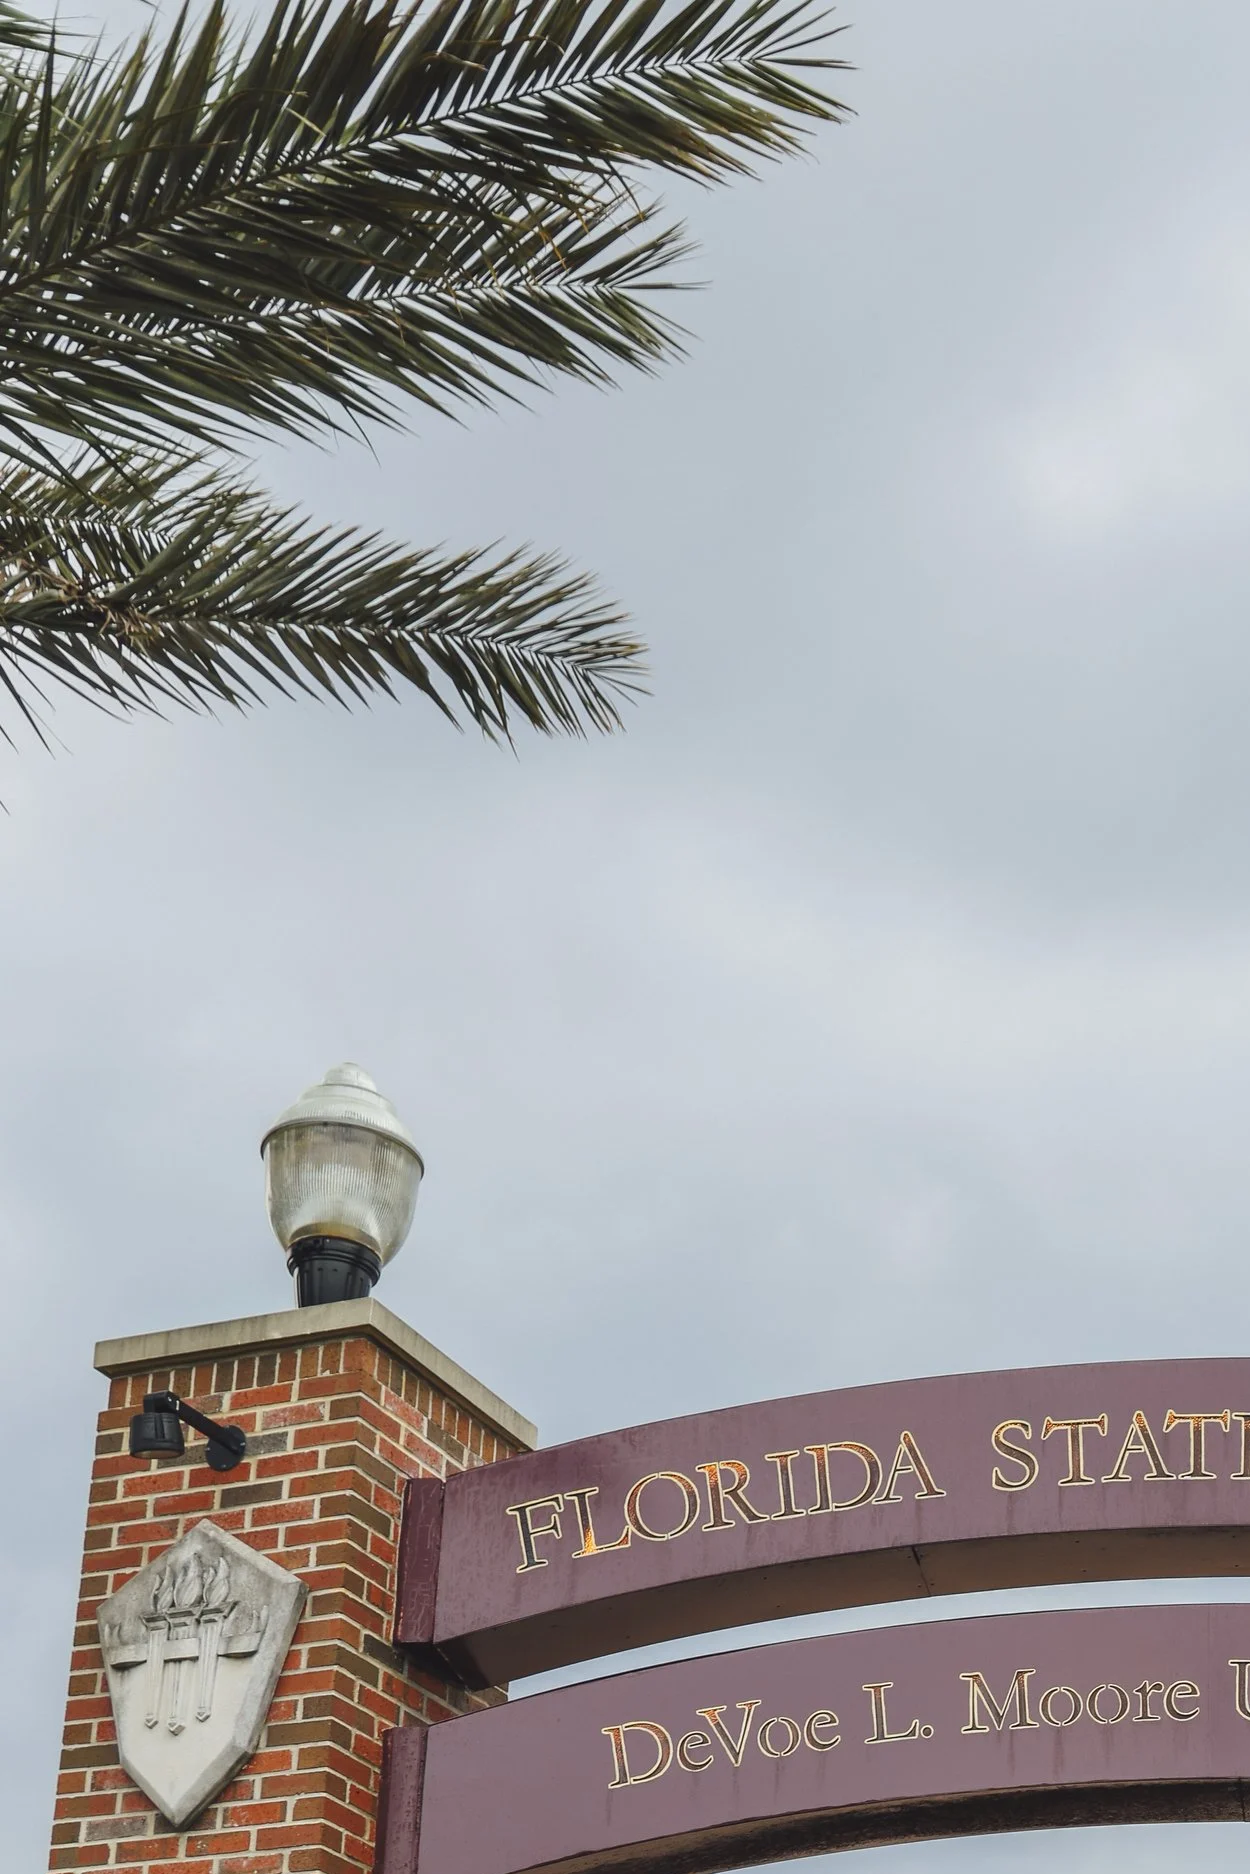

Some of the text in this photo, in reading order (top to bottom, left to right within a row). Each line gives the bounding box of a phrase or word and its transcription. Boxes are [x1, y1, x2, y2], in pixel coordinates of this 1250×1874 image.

[506, 1431, 946, 1573] FLORIDA
[601, 1699, 841, 1789] DeVoe
[862, 1682, 934, 1744] L.
[959, 1668, 1201, 1734] Moore
